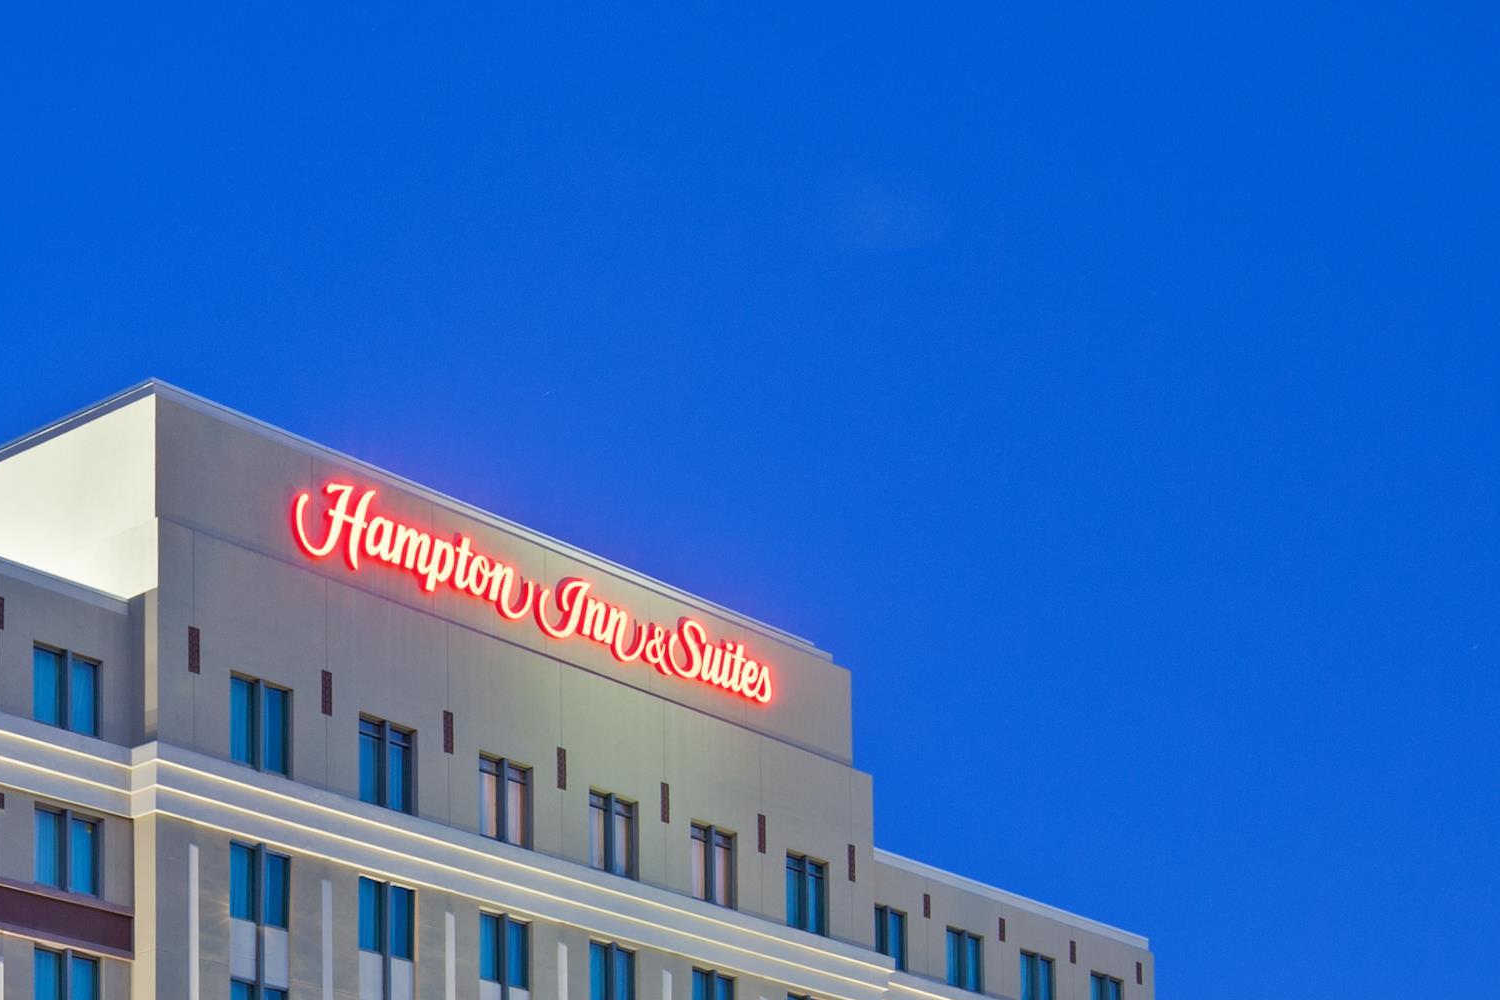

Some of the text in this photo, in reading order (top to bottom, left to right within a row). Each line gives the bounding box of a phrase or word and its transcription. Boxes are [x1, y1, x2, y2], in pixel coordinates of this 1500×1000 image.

[293, 482, 774, 704] Hampton Inn & Suites
